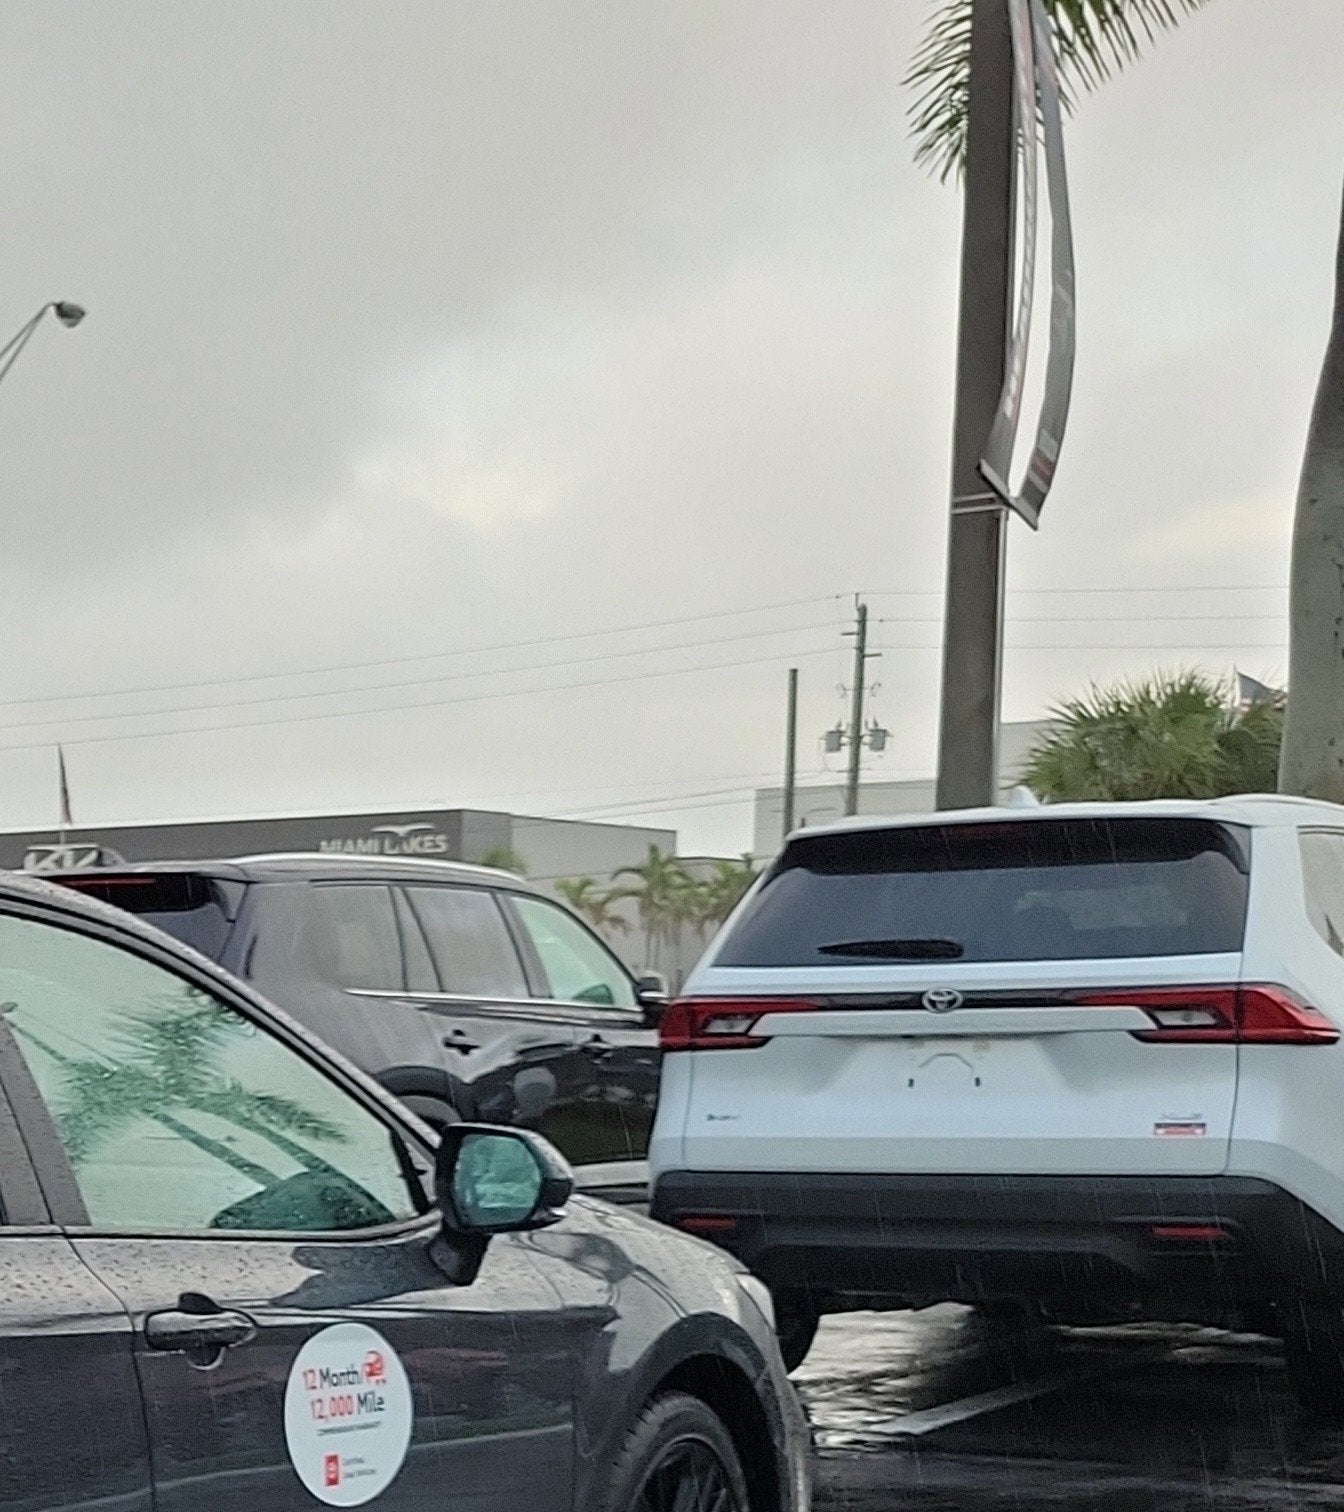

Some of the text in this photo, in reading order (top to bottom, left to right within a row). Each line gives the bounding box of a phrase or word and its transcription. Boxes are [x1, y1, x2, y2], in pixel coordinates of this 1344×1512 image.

[318, 836, 381, 854] MIAMI
[319, 1363, 362, 1389] Month
[357, 1390, 385, 1415] Mile
